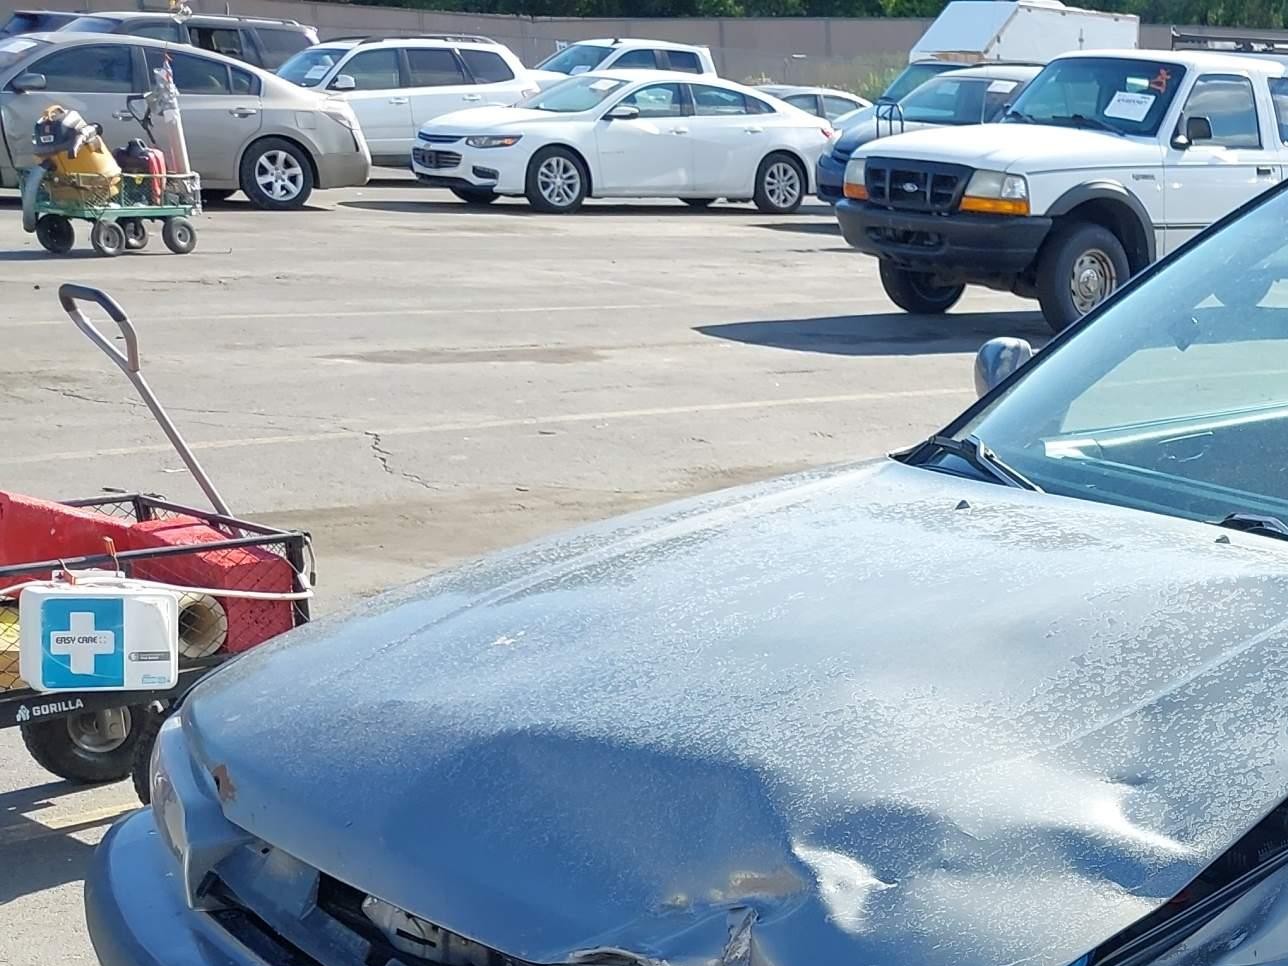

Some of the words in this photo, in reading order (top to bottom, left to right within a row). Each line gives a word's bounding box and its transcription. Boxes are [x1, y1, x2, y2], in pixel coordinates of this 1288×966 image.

[55, 636, 76, 645] EASY
[77, 636, 98, 644] CARE
[32, 698, 84, 717] GORILLA
